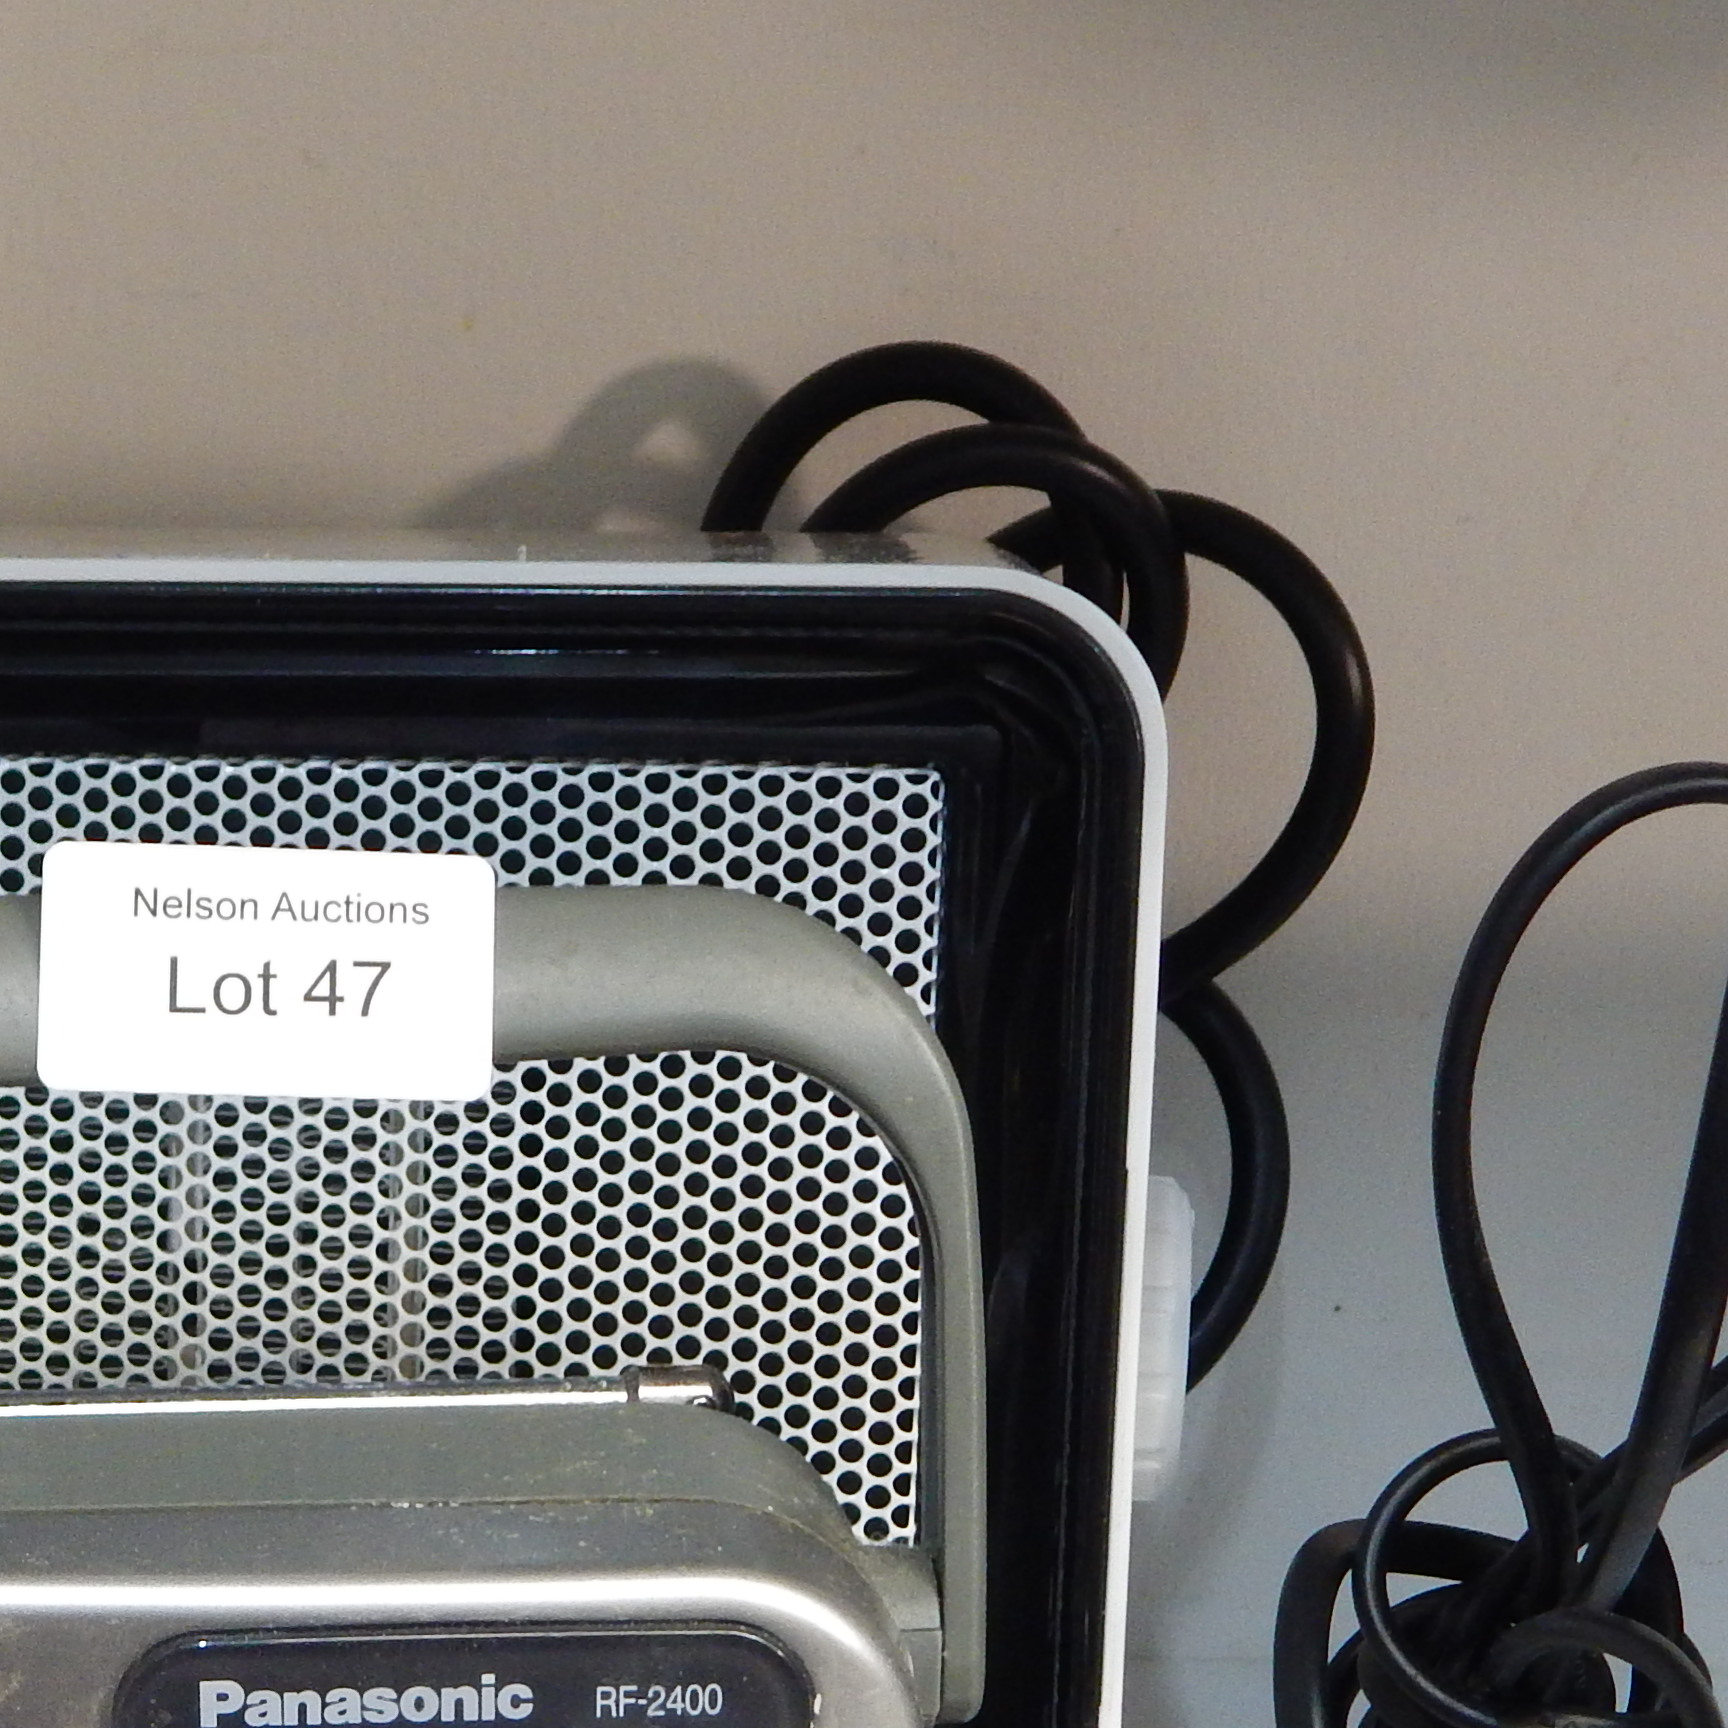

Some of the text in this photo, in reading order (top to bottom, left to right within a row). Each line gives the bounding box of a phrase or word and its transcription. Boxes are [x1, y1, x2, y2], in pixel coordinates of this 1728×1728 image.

[133, 887, 430, 925] Nelson Auctions
[168, 956, 392, 1017] Lot 47
[198, 1673, 535, 1728] Panasonic
[594, 1683, 724, 1719] RF-2400
